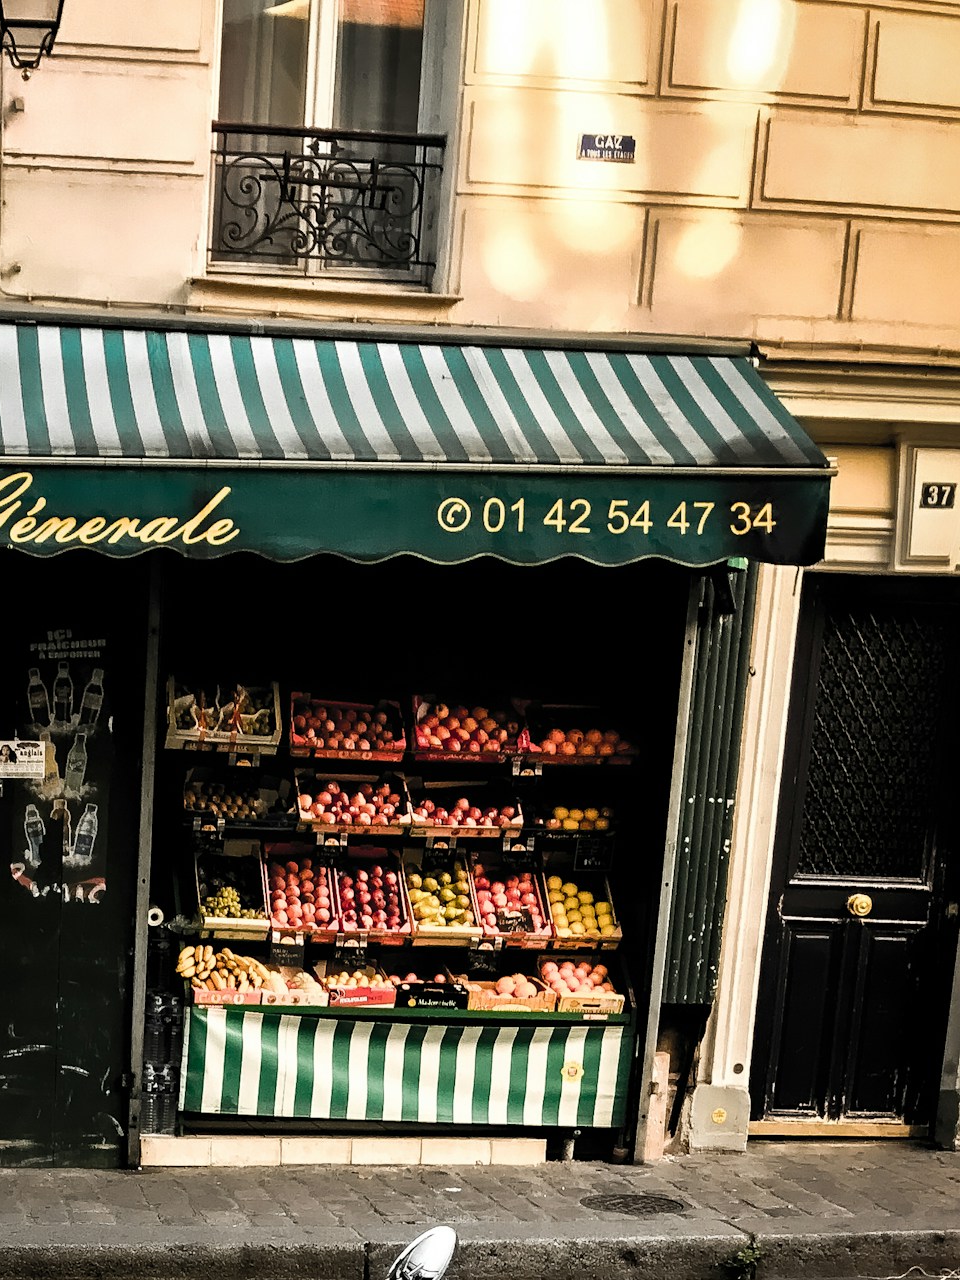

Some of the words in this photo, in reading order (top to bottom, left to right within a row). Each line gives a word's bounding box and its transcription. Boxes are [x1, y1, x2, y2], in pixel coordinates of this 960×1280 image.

[595, 135, 623, 149] GAZ
[927, 485, 951, 506] 37
[483, 497, 525, 533] 01
[543, 498, 591, 534] 42
[607, 499, 654, 535] 54
[667, 500, 715, 536] 47
[730, 501, 777, 536] 34
